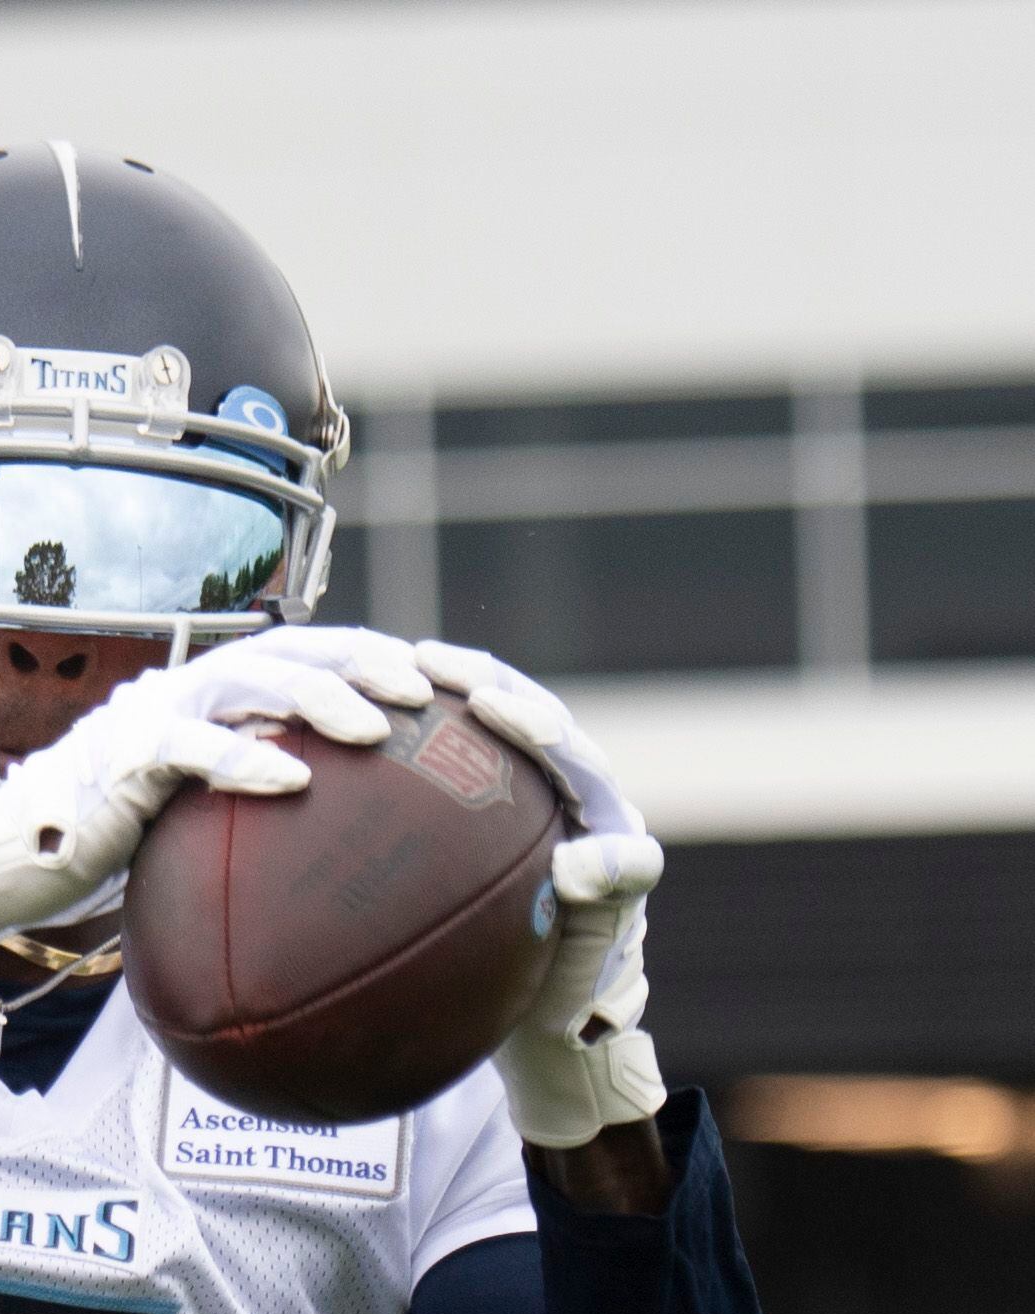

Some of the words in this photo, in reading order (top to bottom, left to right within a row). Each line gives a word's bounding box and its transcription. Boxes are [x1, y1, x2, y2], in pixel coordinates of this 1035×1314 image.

[30, 357, 126, 394] TITANS
[175, 1140, 257, 1167] Saint
[265, 1144, 388, 1182] Thomas
